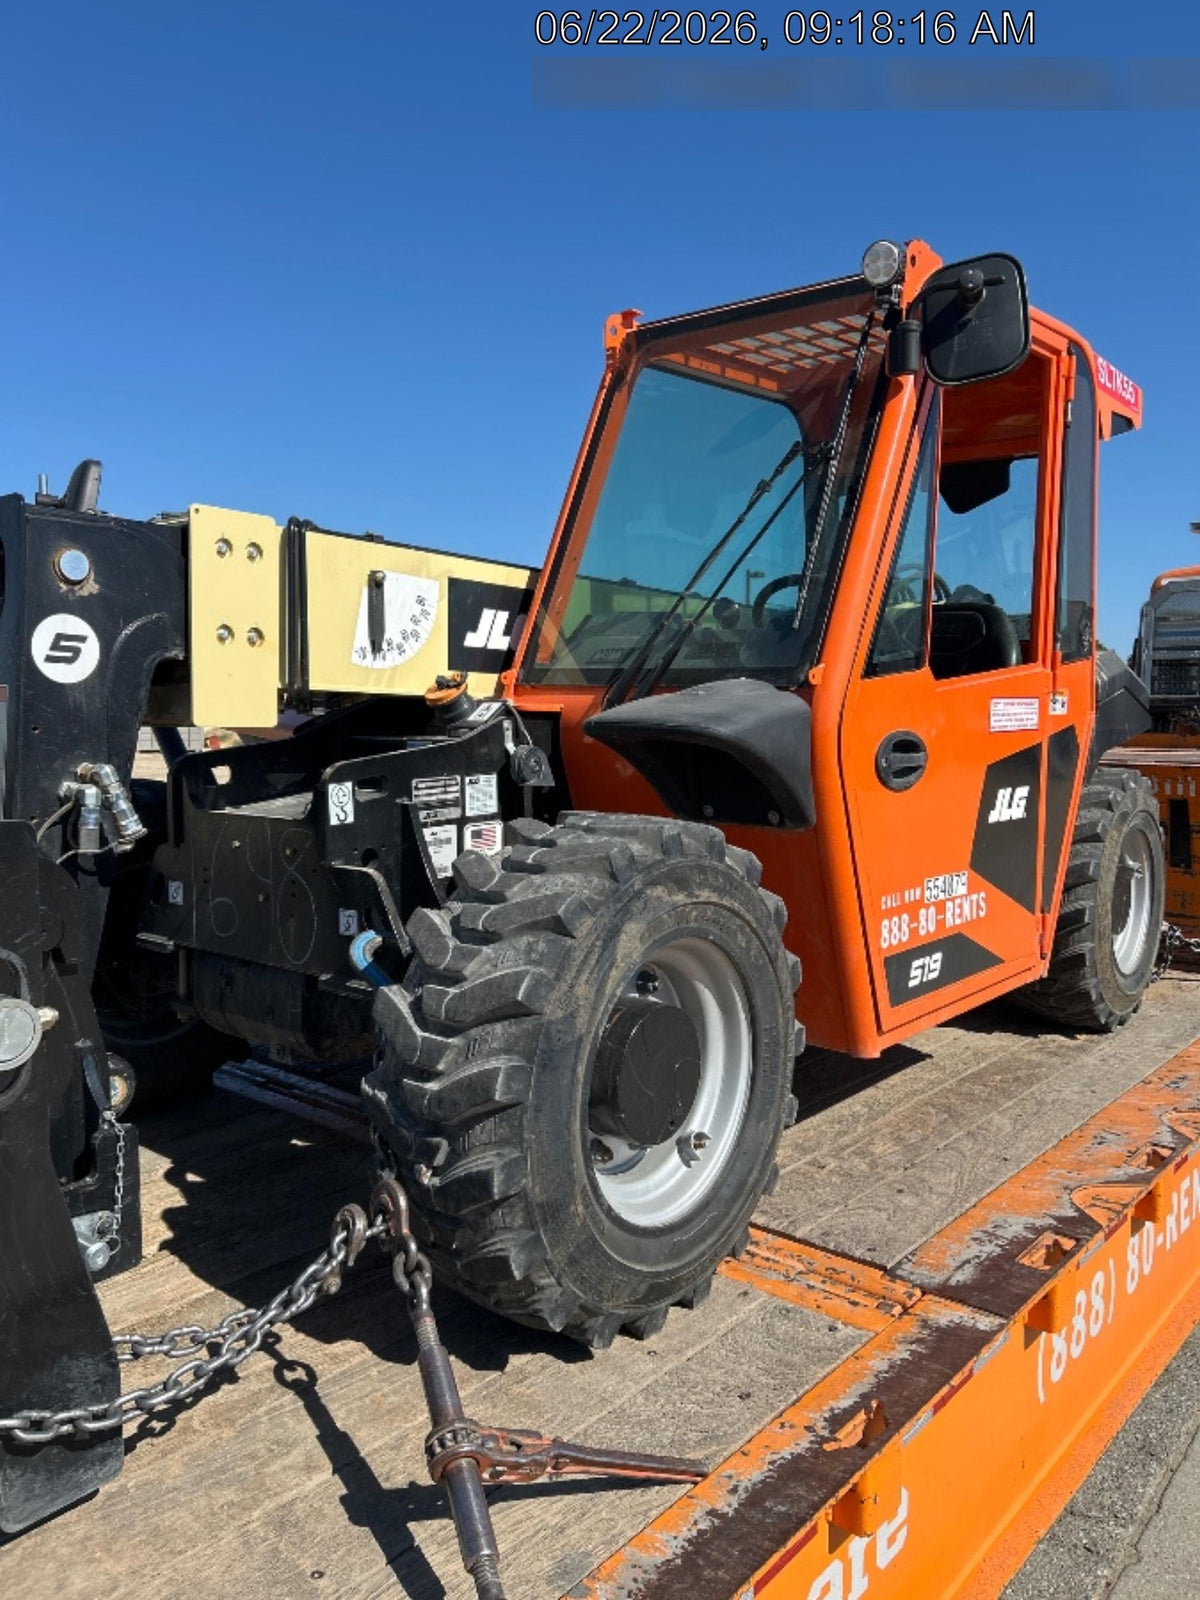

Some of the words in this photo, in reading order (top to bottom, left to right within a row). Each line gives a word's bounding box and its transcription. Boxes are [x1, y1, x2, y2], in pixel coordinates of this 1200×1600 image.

[988, 785, 1030, 824] JLG
[881, 892, 986, 949] 888-80-RENTS
[908, 951, 943, 988] 519
